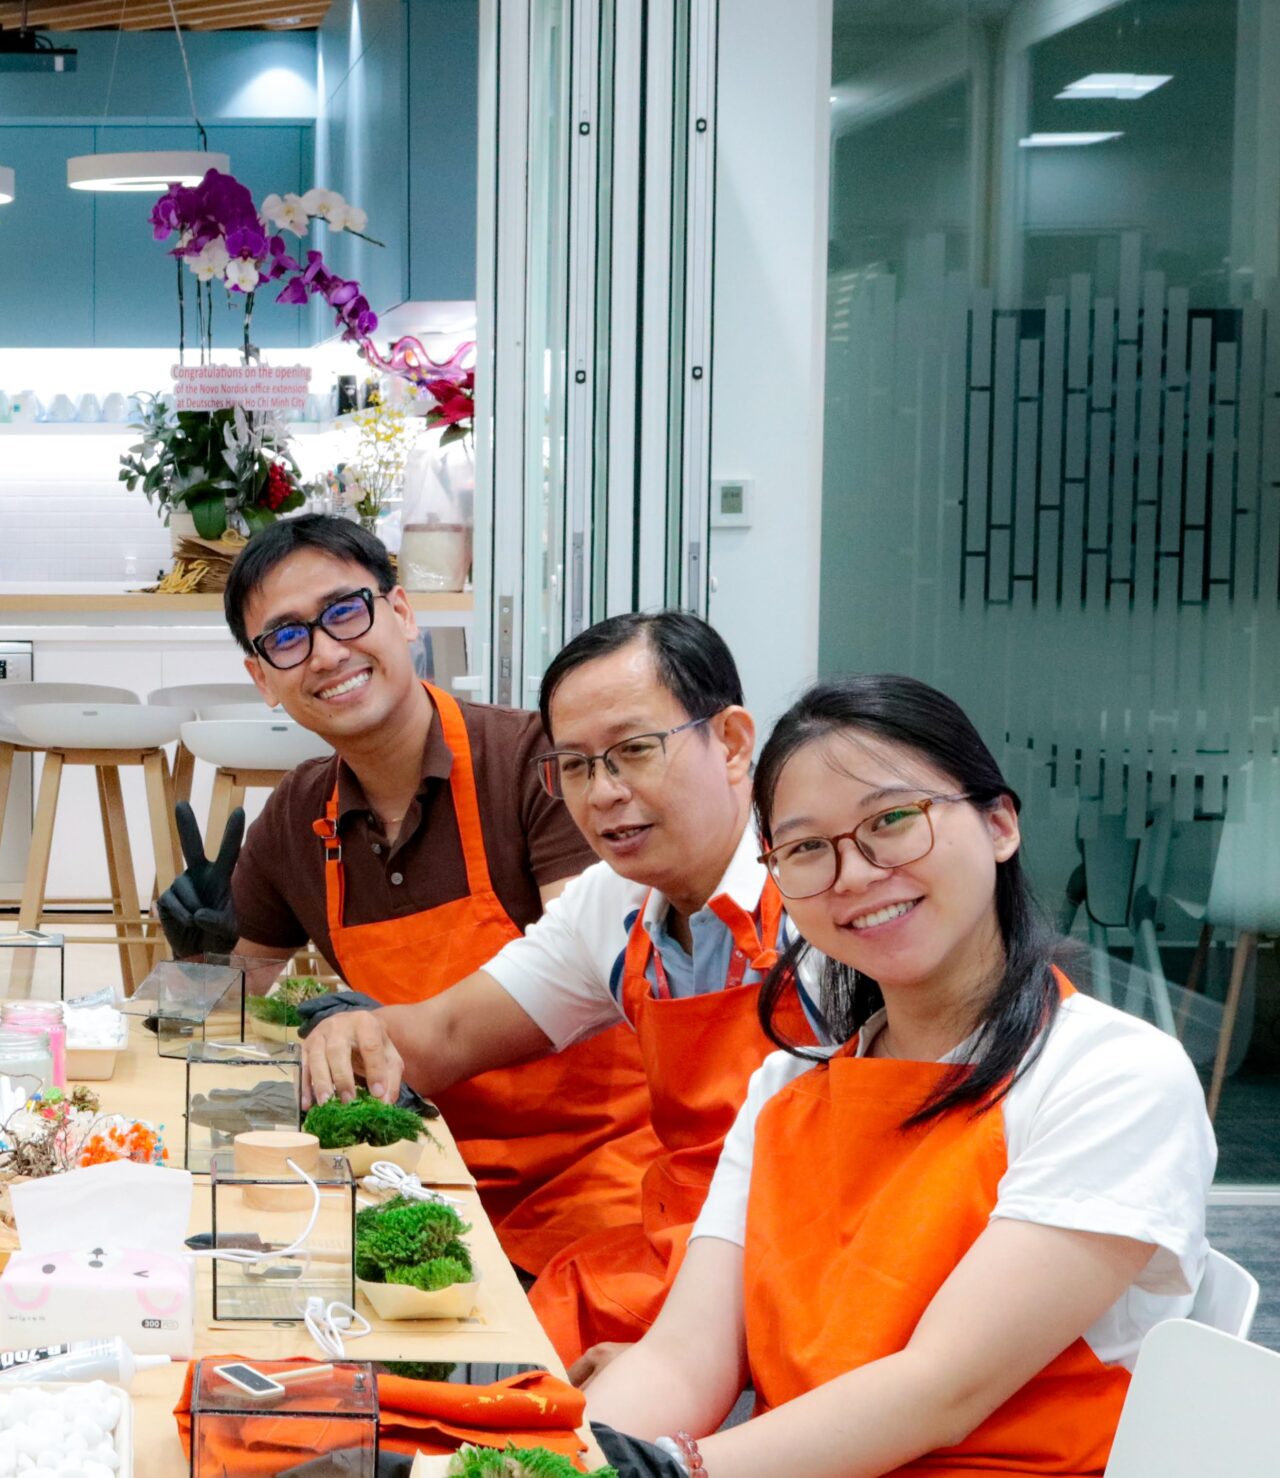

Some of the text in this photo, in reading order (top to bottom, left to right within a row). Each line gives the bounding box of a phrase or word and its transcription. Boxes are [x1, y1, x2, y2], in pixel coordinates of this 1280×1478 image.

[173, 366, 311, 381] Congratulations on the opening
[176, 384, 308, 394] of the Novo Nordisk office extension
[177, 399, 184, 408] at
[186, 398, 223, 408] Deutsches
[245, 399, 256, 408] Ho
[258, 397, 269, 408] Chi
[271, 397, 289, 408] Minh
[291, 397, 305, 409] City
[144, 1319, 160, 1329] 300
